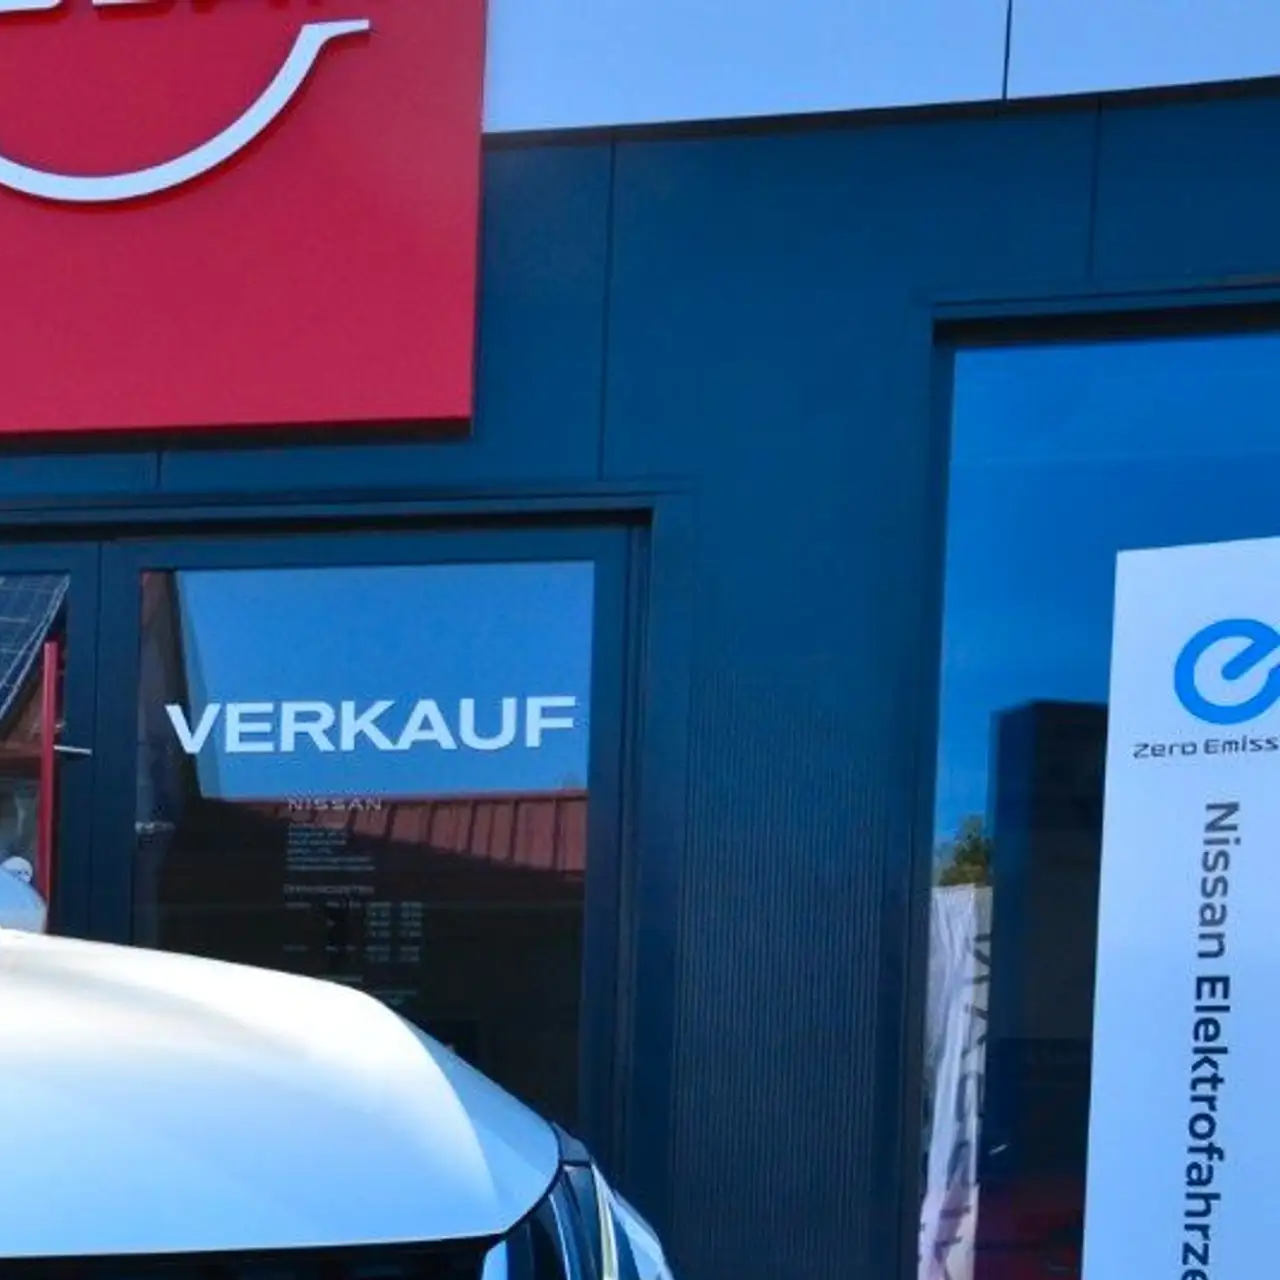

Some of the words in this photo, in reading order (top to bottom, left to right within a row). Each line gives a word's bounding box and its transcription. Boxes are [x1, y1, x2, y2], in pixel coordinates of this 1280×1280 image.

[165, 696, 576, 753] VERKAUF
[1133, 742, 1198, 758] Zero
[287, 796, 382, 811] NISSAN
[1197, 801, 1241, 960] Nissan
